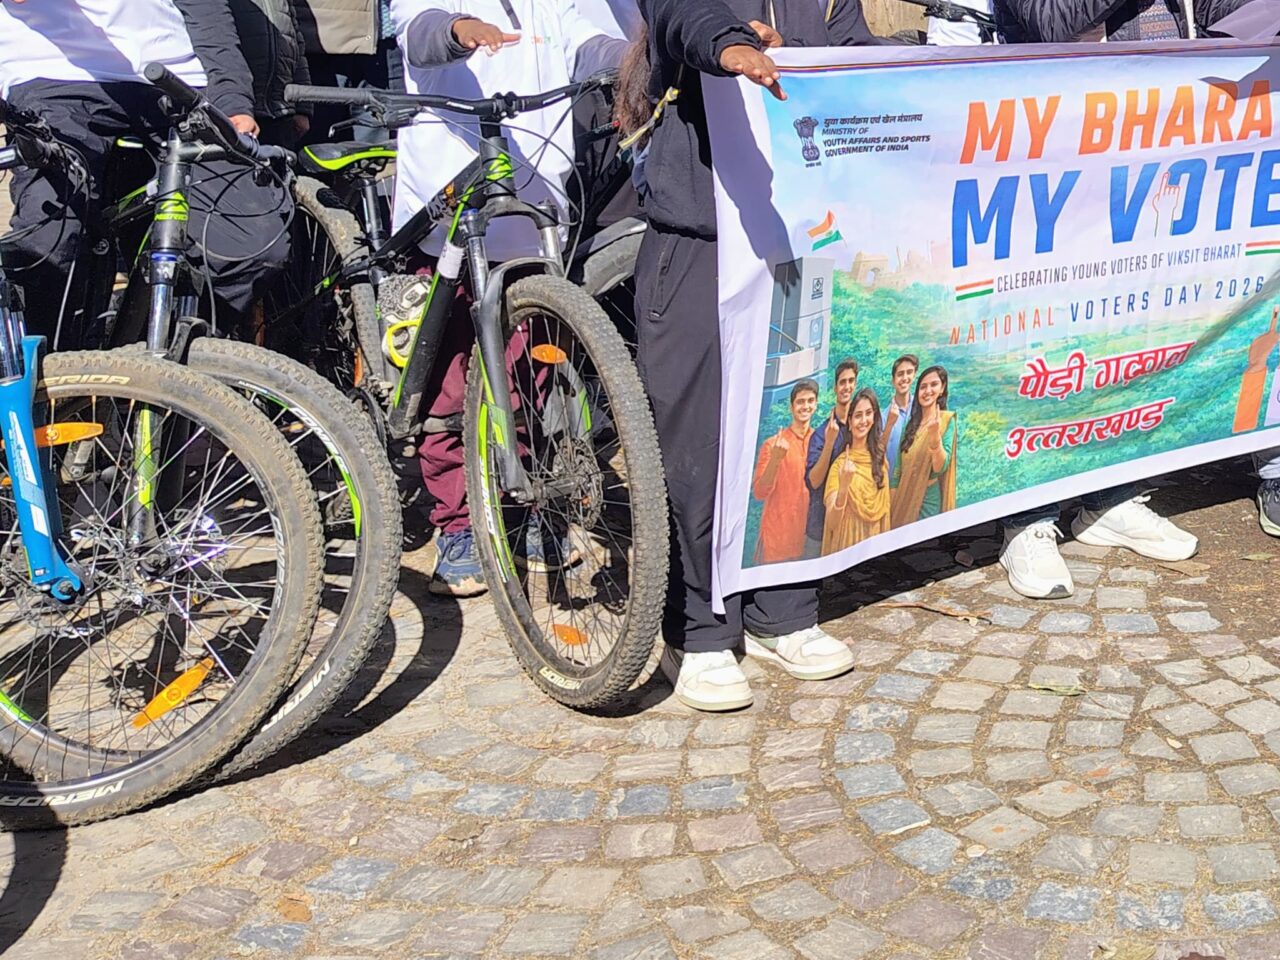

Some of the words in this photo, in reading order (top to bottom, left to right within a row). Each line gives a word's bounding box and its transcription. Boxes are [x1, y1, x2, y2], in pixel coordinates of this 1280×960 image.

[821, 126, 857, 136] MINISTRY
[858, 127, 870, 135] OF
[822, 138, 848, 148] YOUTH
[848, 136, 881, 145] AFFAIRS
[882, 135, 900, 144] AND
[900, 134, 931, 143] SPORTS
[824, 145, 874, 158] GOVERNMENT
[875, 144, 886, 152] OF
[887, 143, 909, 152] INDIA
[959, 94, 1062, 165] MY
[951, 169, 1082, 269] MY
[997, 267, 1068, 293] CELEBRATING
[1070, 260, 1107, 279] YOUNG
[1110, 254, 1148, 276] VOTERS
[1151, 252, 1165, 270] OF
[1167, 246, 1200, 268] VIKSIT
[1202, 242, 1243, 263] BHARAT
[948, 305, 1056, 346] NATIONAL
[1070, 291, 1150, 323] VOTERS
[1164, 282, 1204, 308] DAY
[1214, 275, 1266, 300] 2026
[43, 373, 131, 385] ERIDA
[1018, 350, 1088, 399] पौड़ी
[1094, 341, 1196, 386] गढ़वाल
[1005, 398, 1175, 459] उत्तराखण्ड
